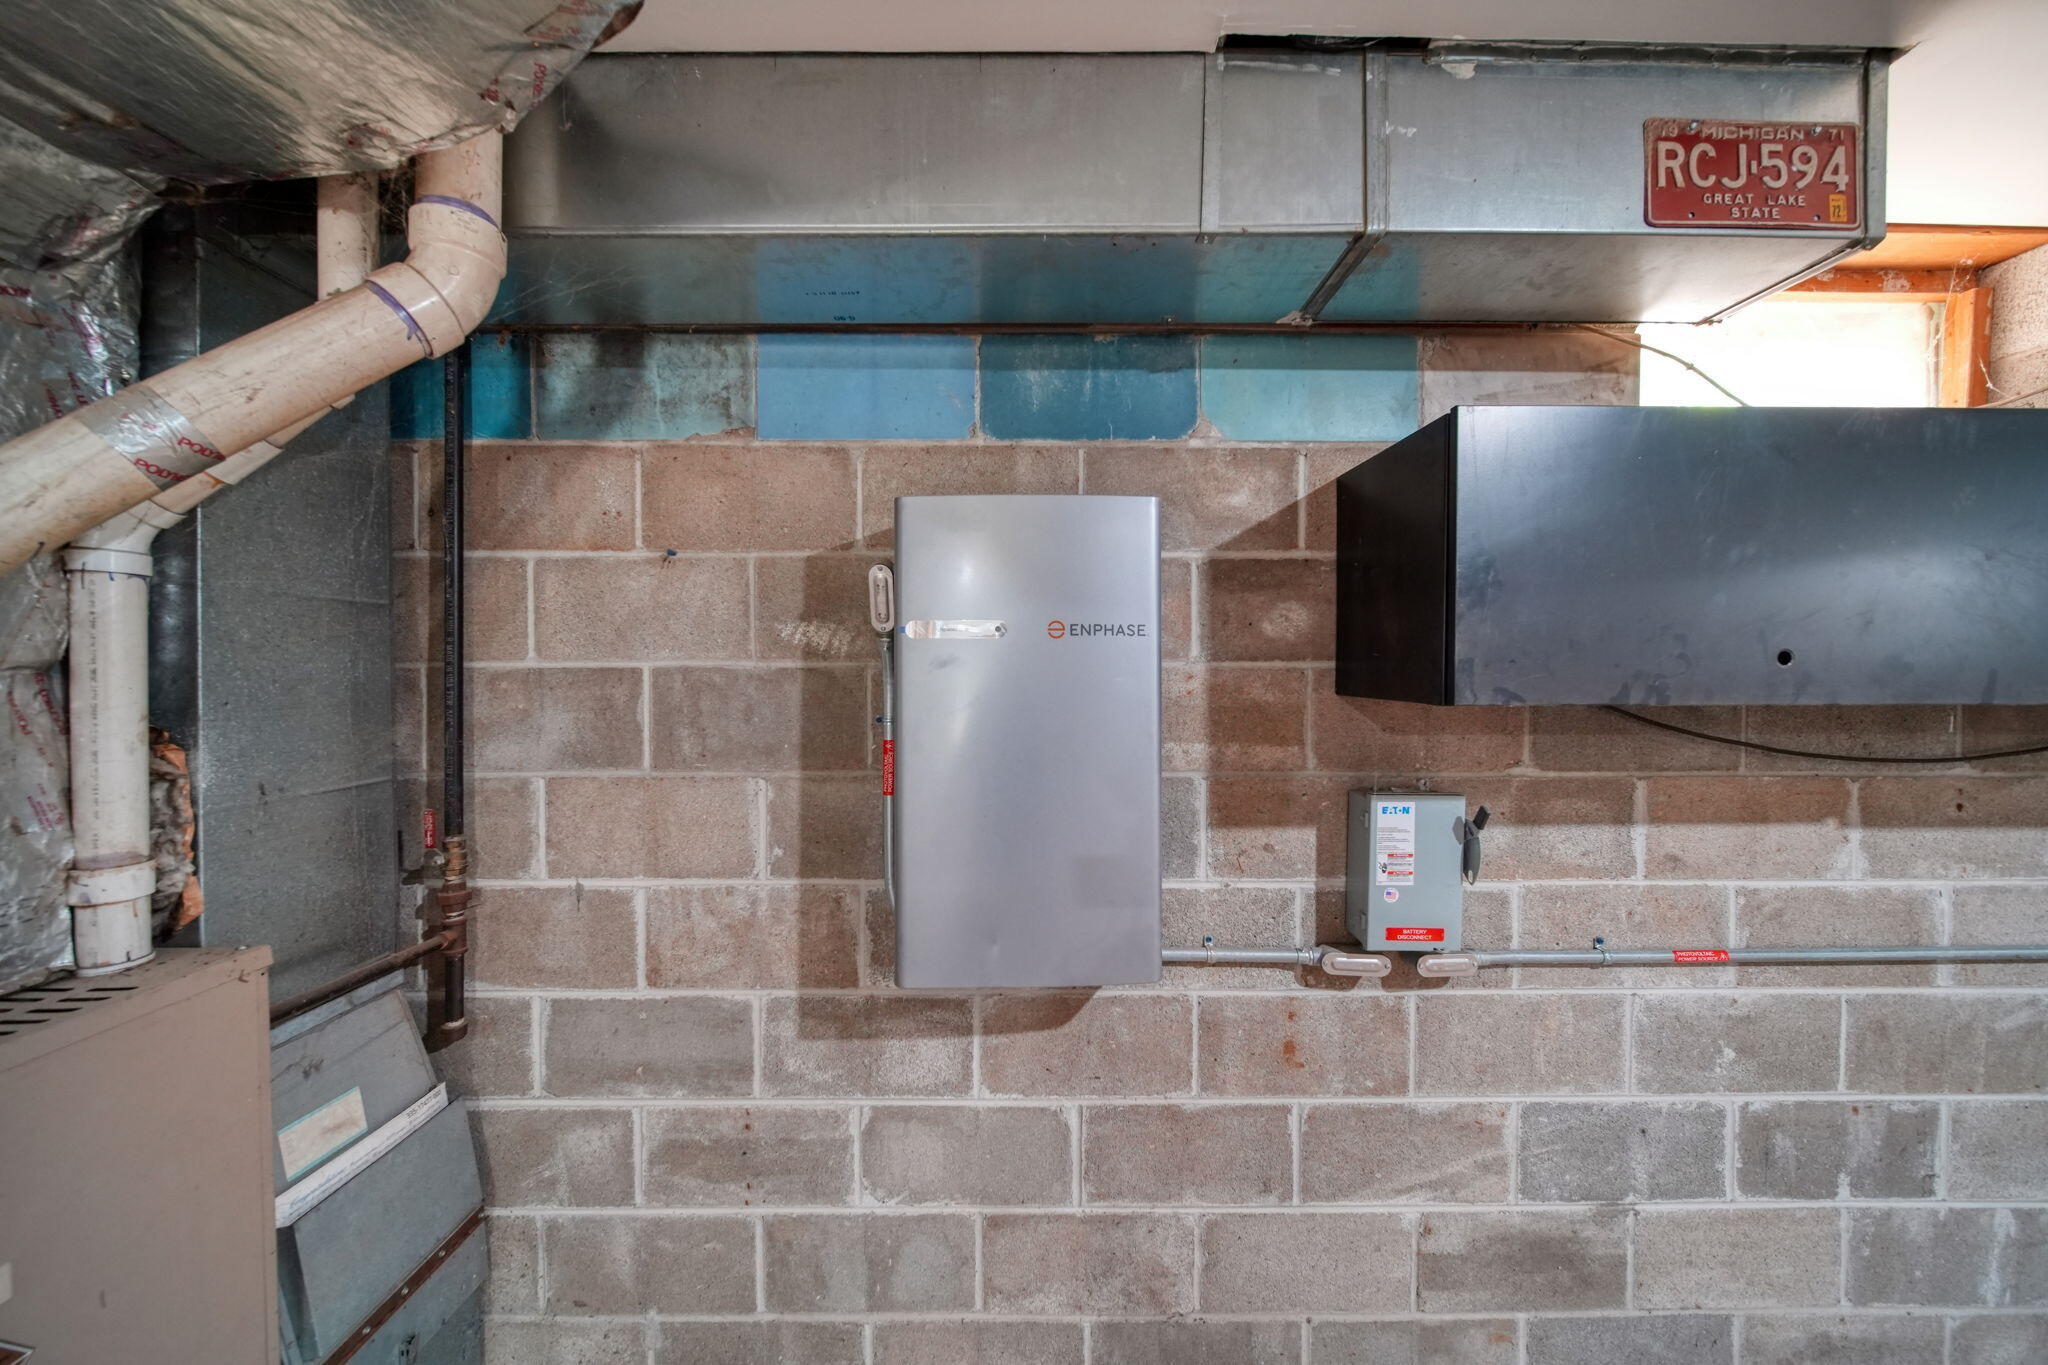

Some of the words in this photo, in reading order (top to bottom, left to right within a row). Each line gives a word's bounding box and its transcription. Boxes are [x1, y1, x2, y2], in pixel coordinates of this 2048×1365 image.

[1701, 126, 1805, 141] MICHIGAN
[1828, 129, 1844, 140] 71
[1703, 193, 1754, 205] GREAT
[1767, 194, 1807, 206] LAKE
[1731, 207, 1782, 219] STATE
[1069, 623, 1147, 637] ENPHASE
